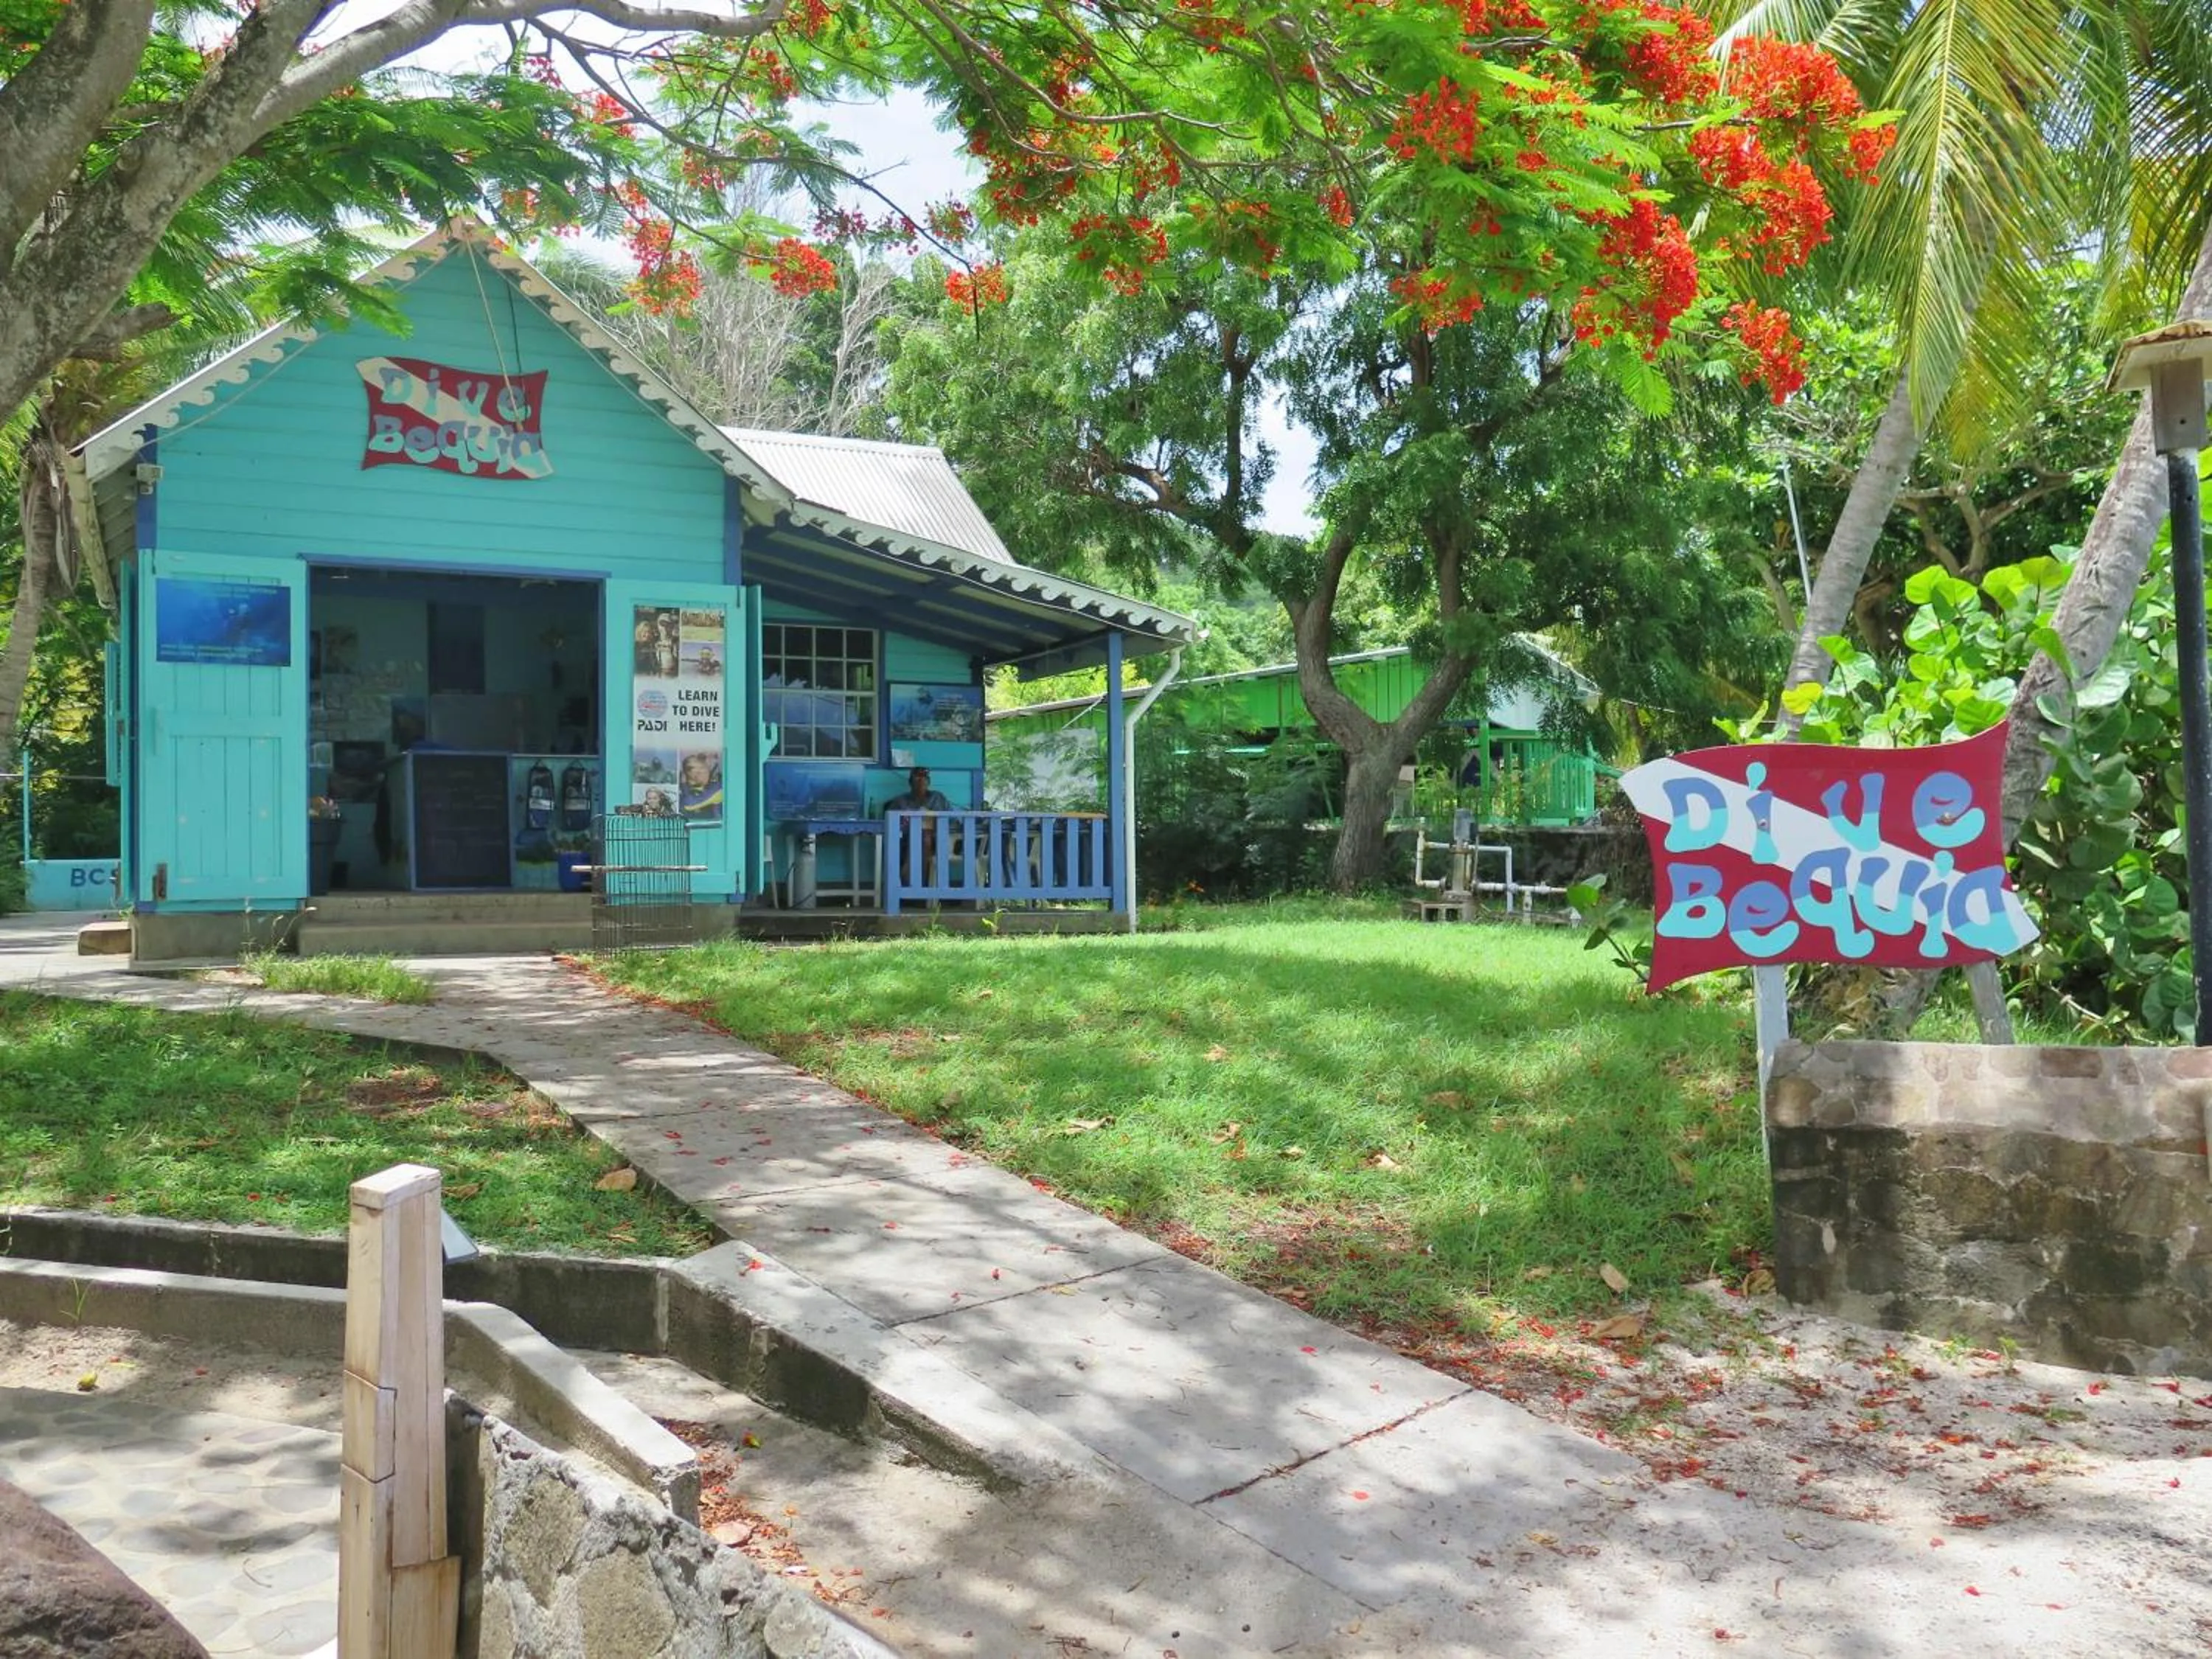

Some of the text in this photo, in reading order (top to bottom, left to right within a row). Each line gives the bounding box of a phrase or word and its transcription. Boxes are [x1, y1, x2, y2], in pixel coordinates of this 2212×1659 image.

[379, 367, 532, 422] Dive
[369, 414, 551, 475] Bequia
[672, 704, 720, 717] TO DIVE
[678, 689, 717, 702] LEARN
[637, 720, 667, 731] PADI
[679, 720, 716, 732] HERE!
[1662, 761, 1986, 865] Dive
[1656, 846, 2022, 959] Bequia
